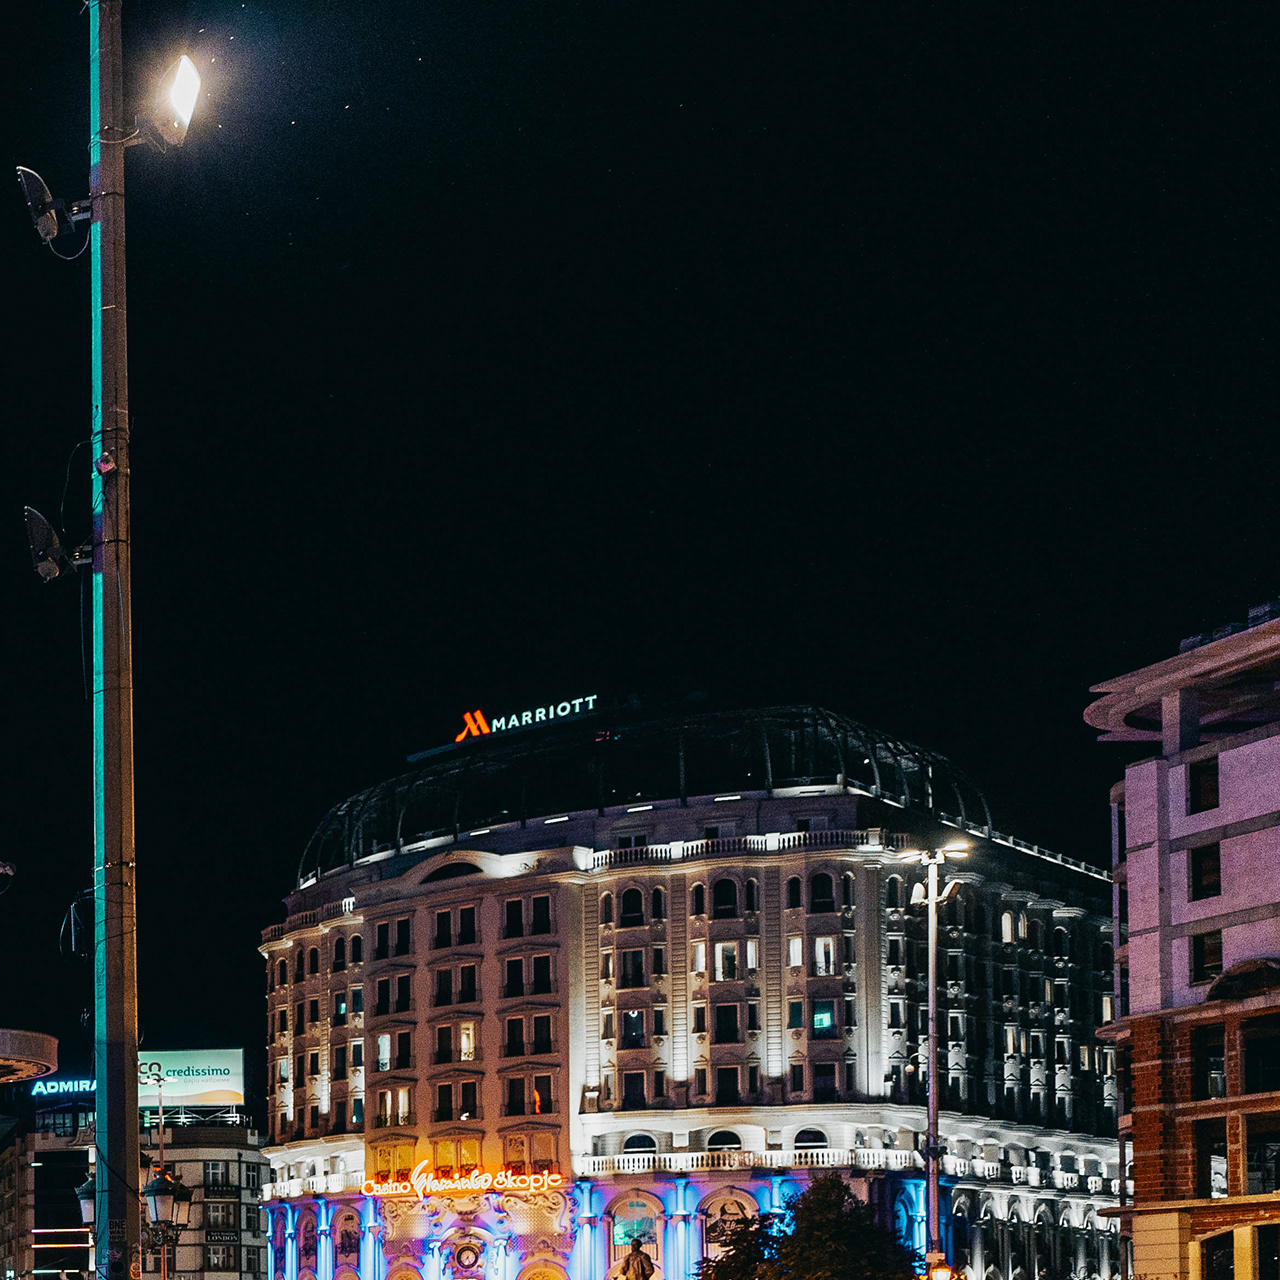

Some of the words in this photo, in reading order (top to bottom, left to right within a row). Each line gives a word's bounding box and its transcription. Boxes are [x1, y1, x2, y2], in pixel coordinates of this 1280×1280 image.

[492, 694, 598, 733] MARRIOTT
[165, 1065, 230, 1077] credissimo
[360, 1179, 411, 1196] Casino
[493, 1169, 562, 1193] Skopje
